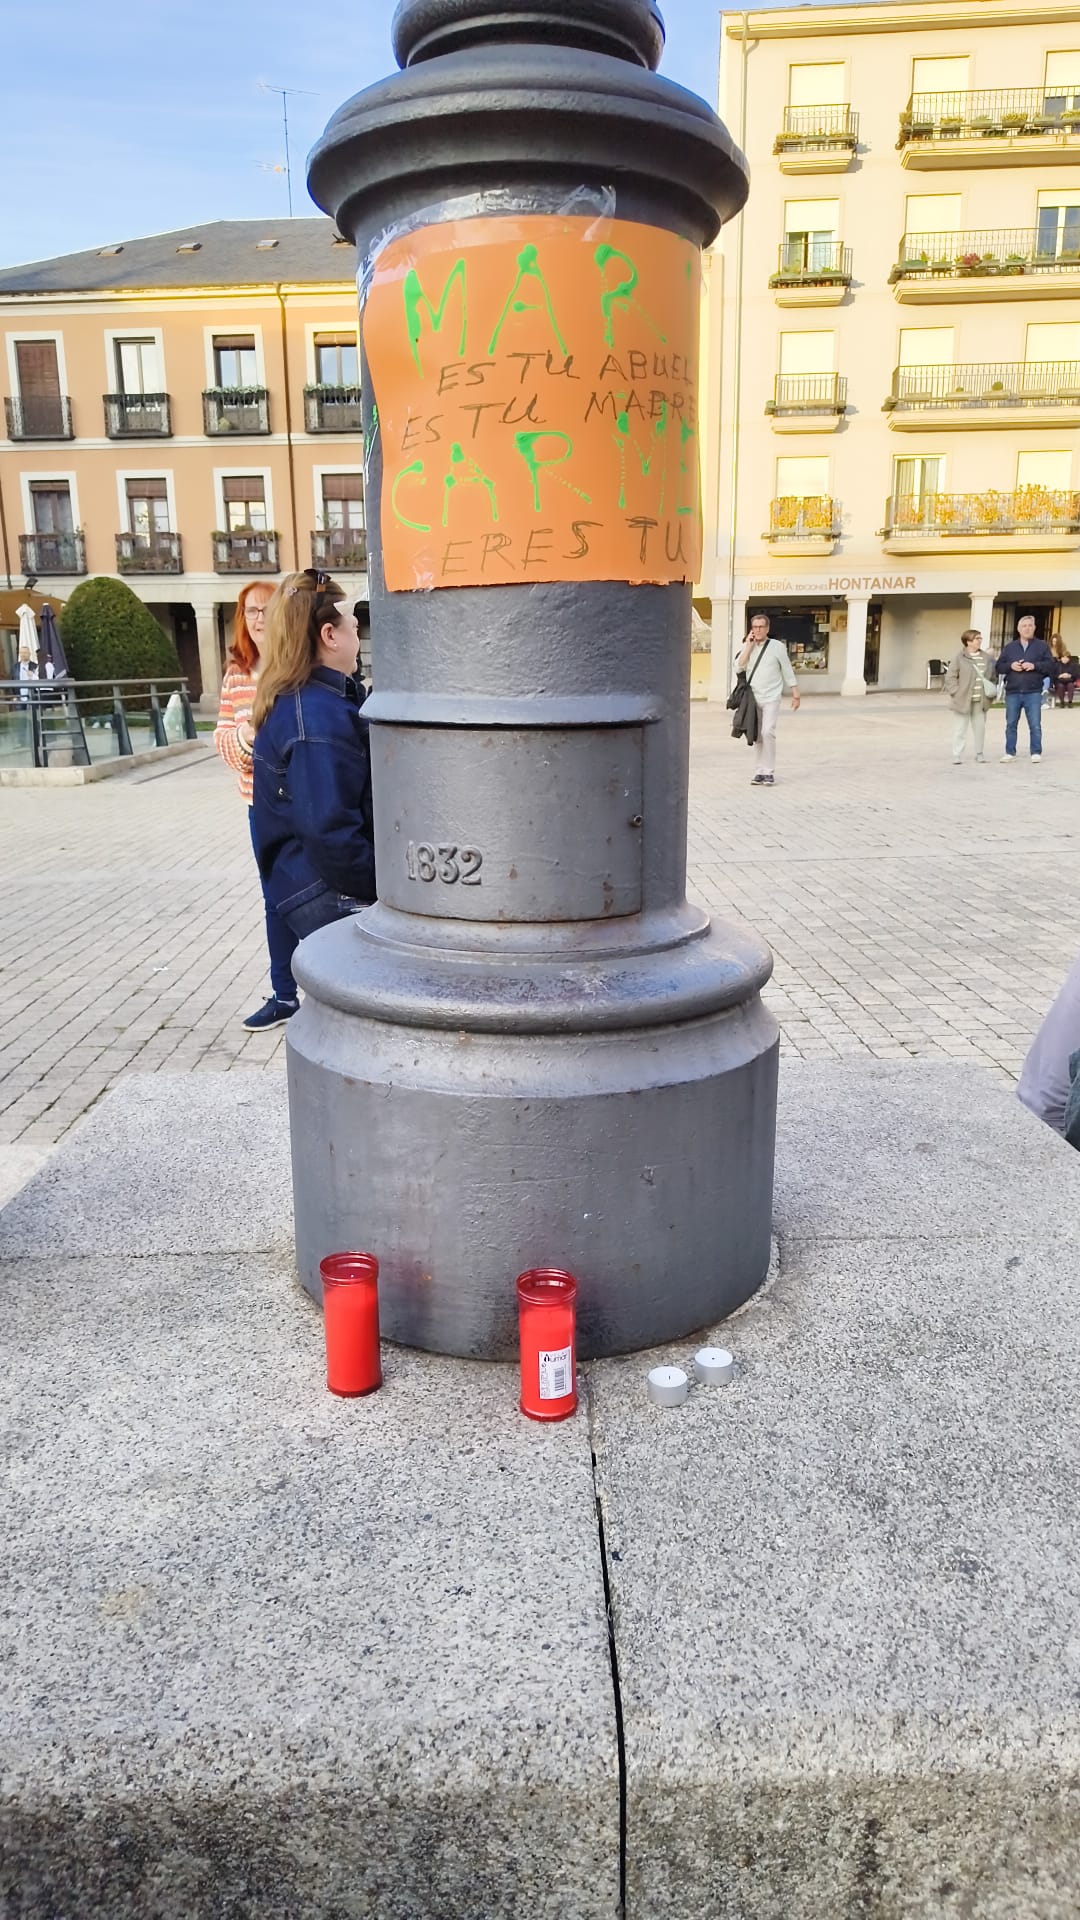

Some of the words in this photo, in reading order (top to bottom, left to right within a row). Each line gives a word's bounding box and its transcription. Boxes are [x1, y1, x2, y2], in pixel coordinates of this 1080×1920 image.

[438, 362, 495, 396] ES
[401, 414, 443, 451] ES
[441, 519, 603, 577] ERES
[625, 516, 688, 565] TU
[828, 576, 916, 591] HONTANAR
[406, 840, 483, 885] 1832
